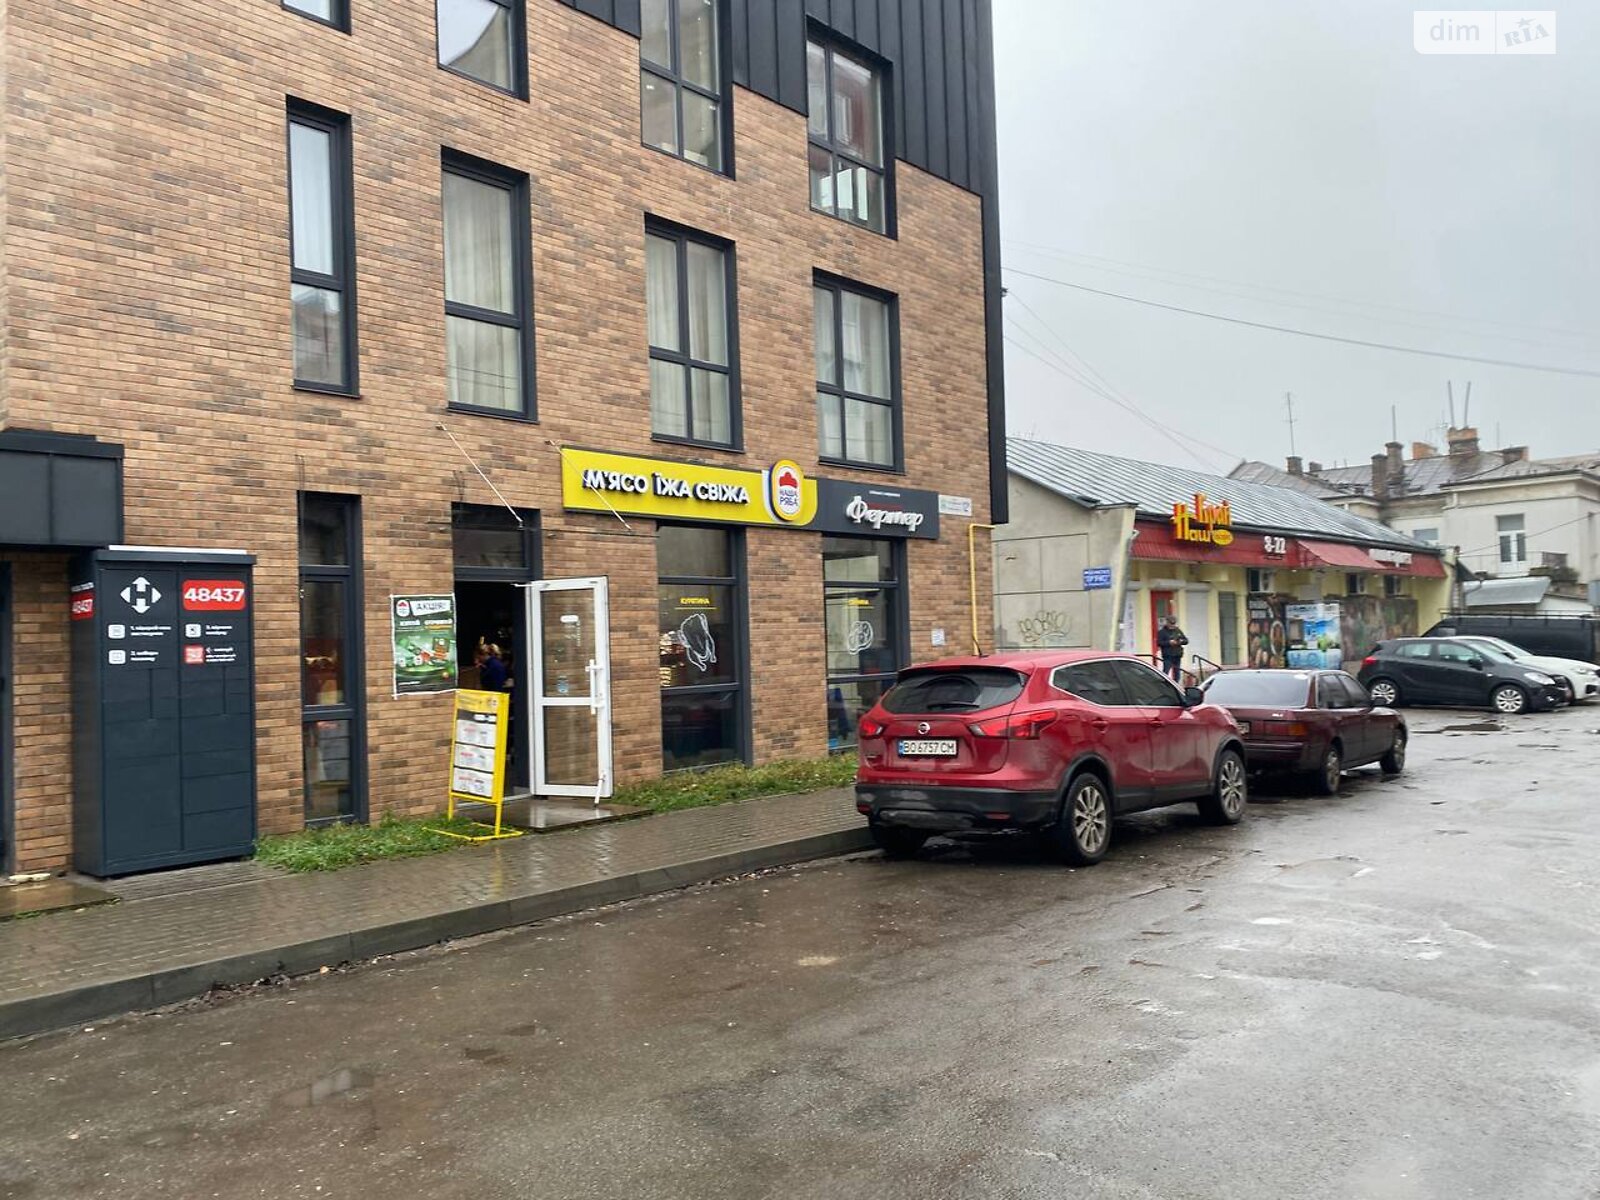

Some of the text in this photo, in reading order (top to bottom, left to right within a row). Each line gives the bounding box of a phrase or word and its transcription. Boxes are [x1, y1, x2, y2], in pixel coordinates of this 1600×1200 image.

[584, 470, 750, 505] М'ЯСО ЇЖА СВІЖА
[846, 496, 924, 531] Фермер
[184, 588, 245, 602] 48437
[918, 742, 939, 753] 6757
